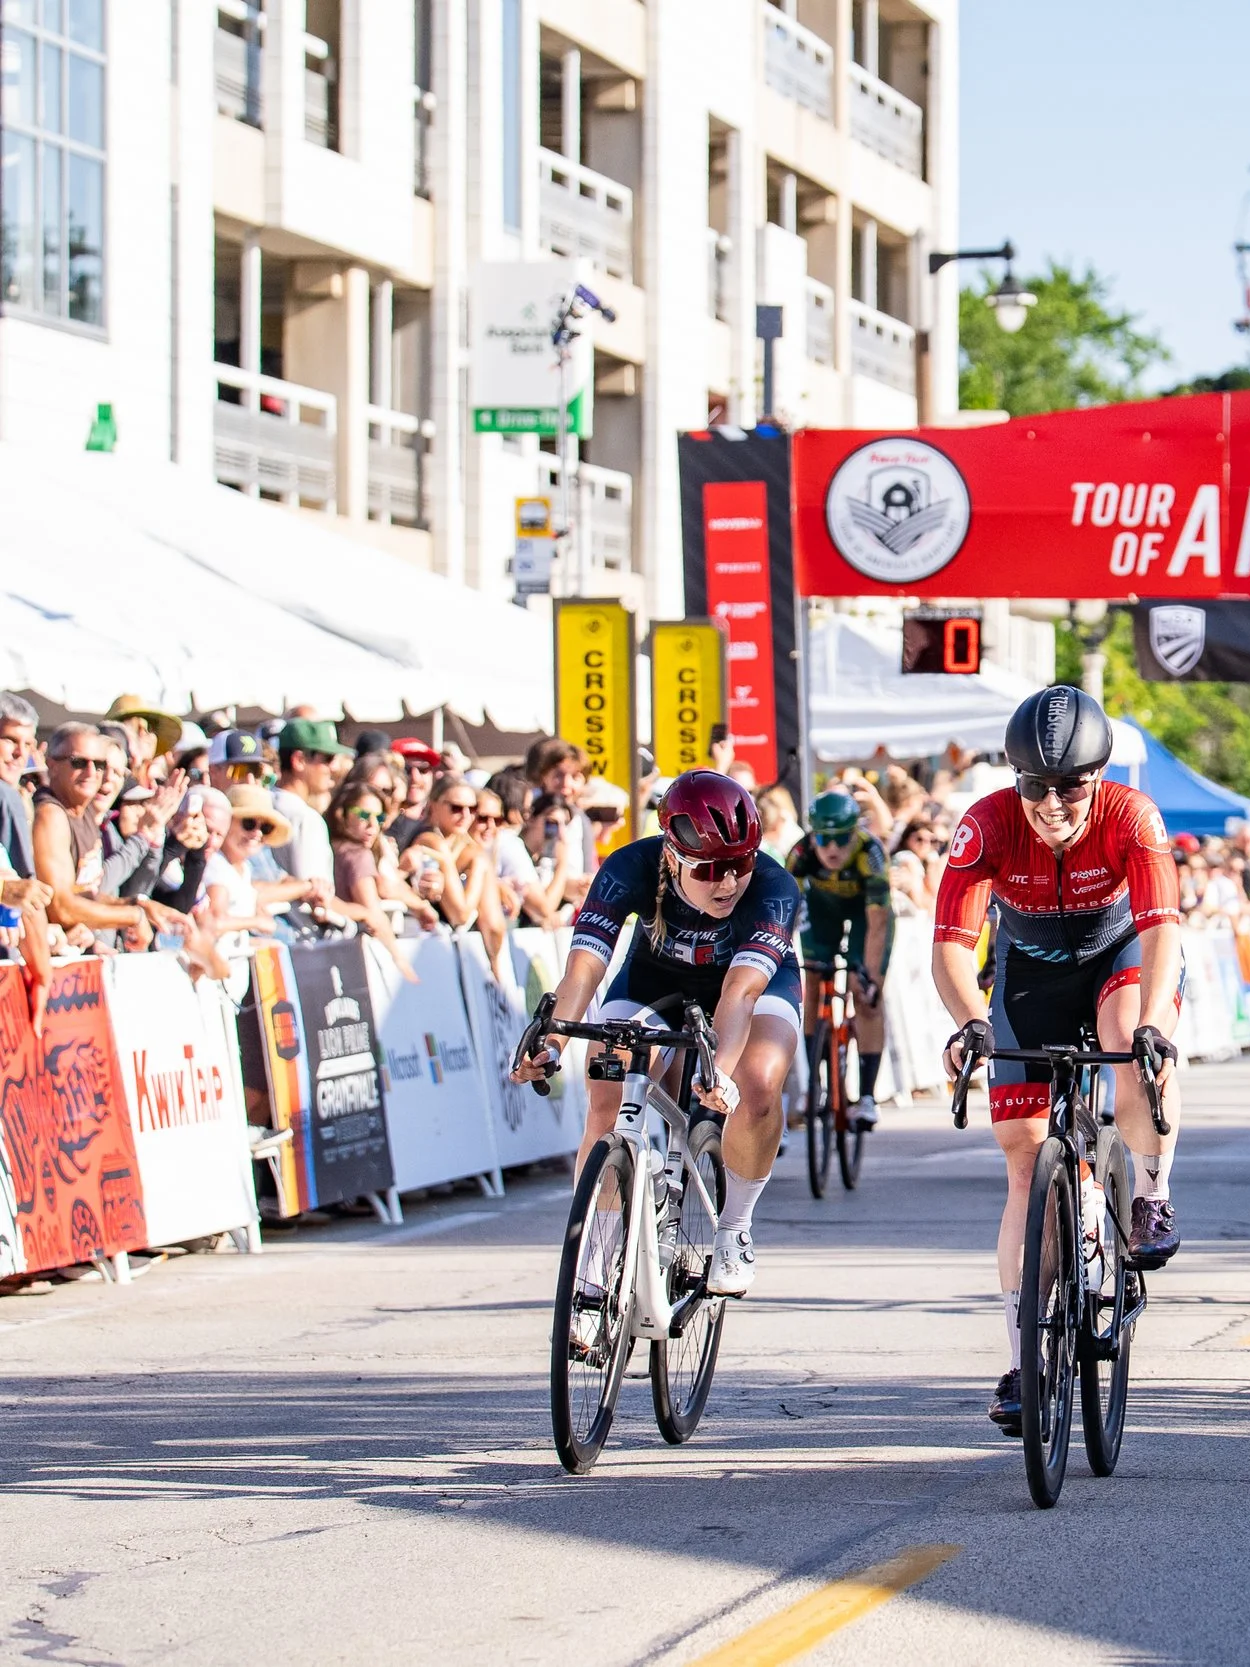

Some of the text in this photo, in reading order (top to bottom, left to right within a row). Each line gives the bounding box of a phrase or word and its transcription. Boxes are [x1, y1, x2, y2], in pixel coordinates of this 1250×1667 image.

[1070, 481, 1176, 528] TOUR
[1109, 531, 1165, 577] OF
[944, 617, 979, 674] 0
[1070, 866, 1108, 880] PANDA
[1003, 889, 1122, 911] BUTCHERBOX
[675, 929, 719, 941] FEMME
